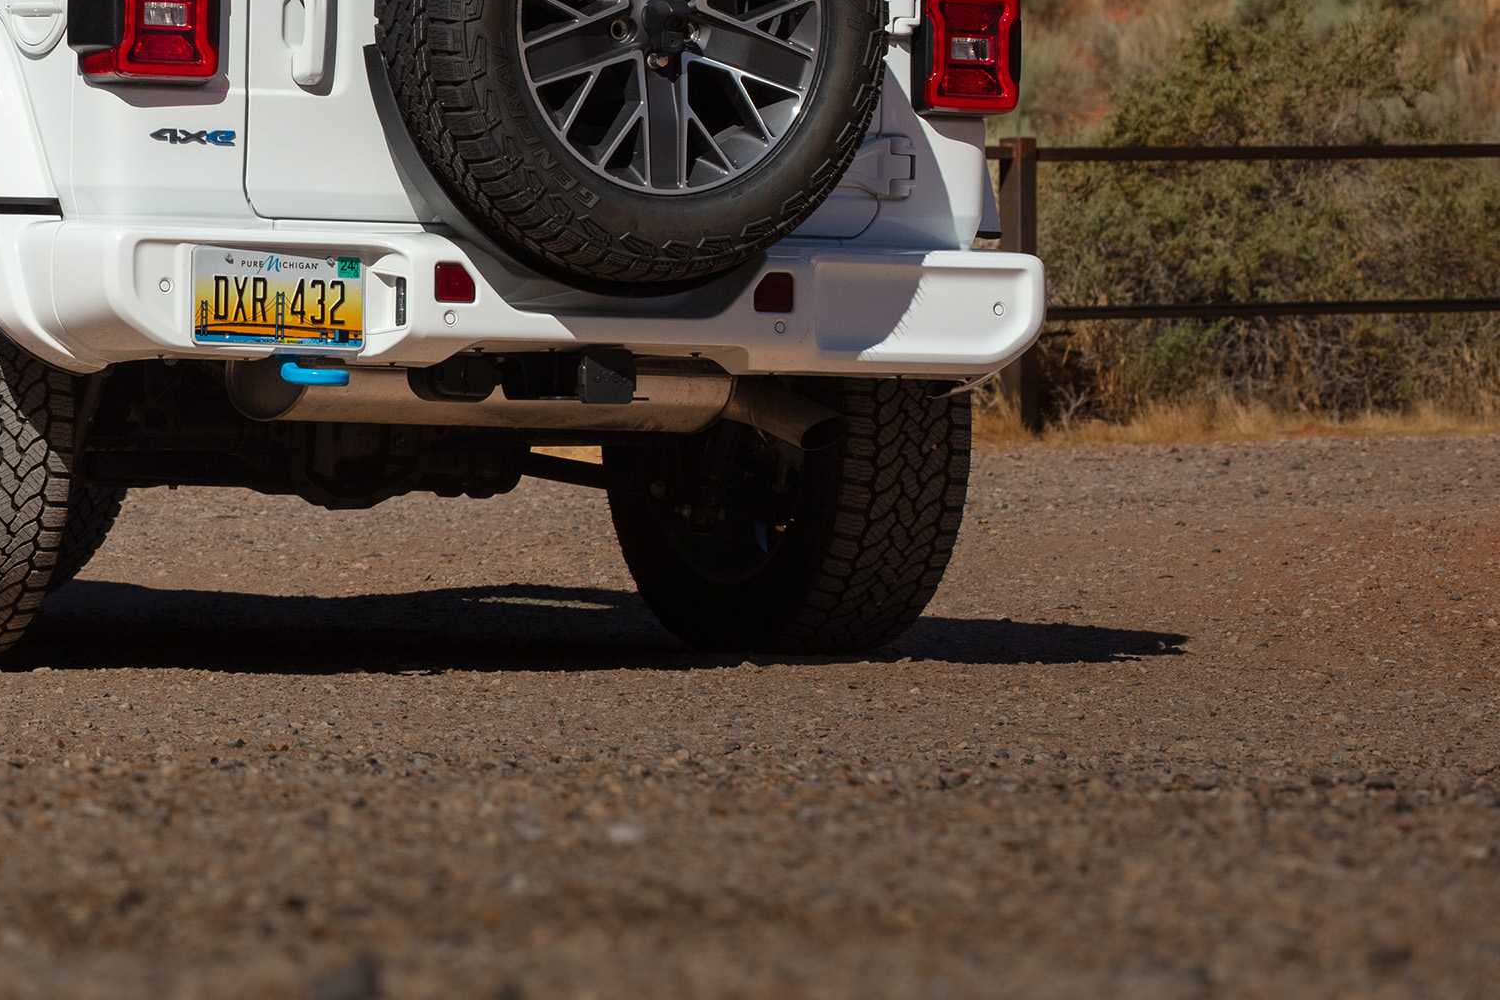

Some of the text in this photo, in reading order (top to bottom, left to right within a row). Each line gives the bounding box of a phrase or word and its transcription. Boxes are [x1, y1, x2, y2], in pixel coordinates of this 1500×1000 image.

[241, 255, 318, 273] PURE MICHIGAN
[340, 259, 356, 271] 24
[213, 275, 346, 326] DXR 432
